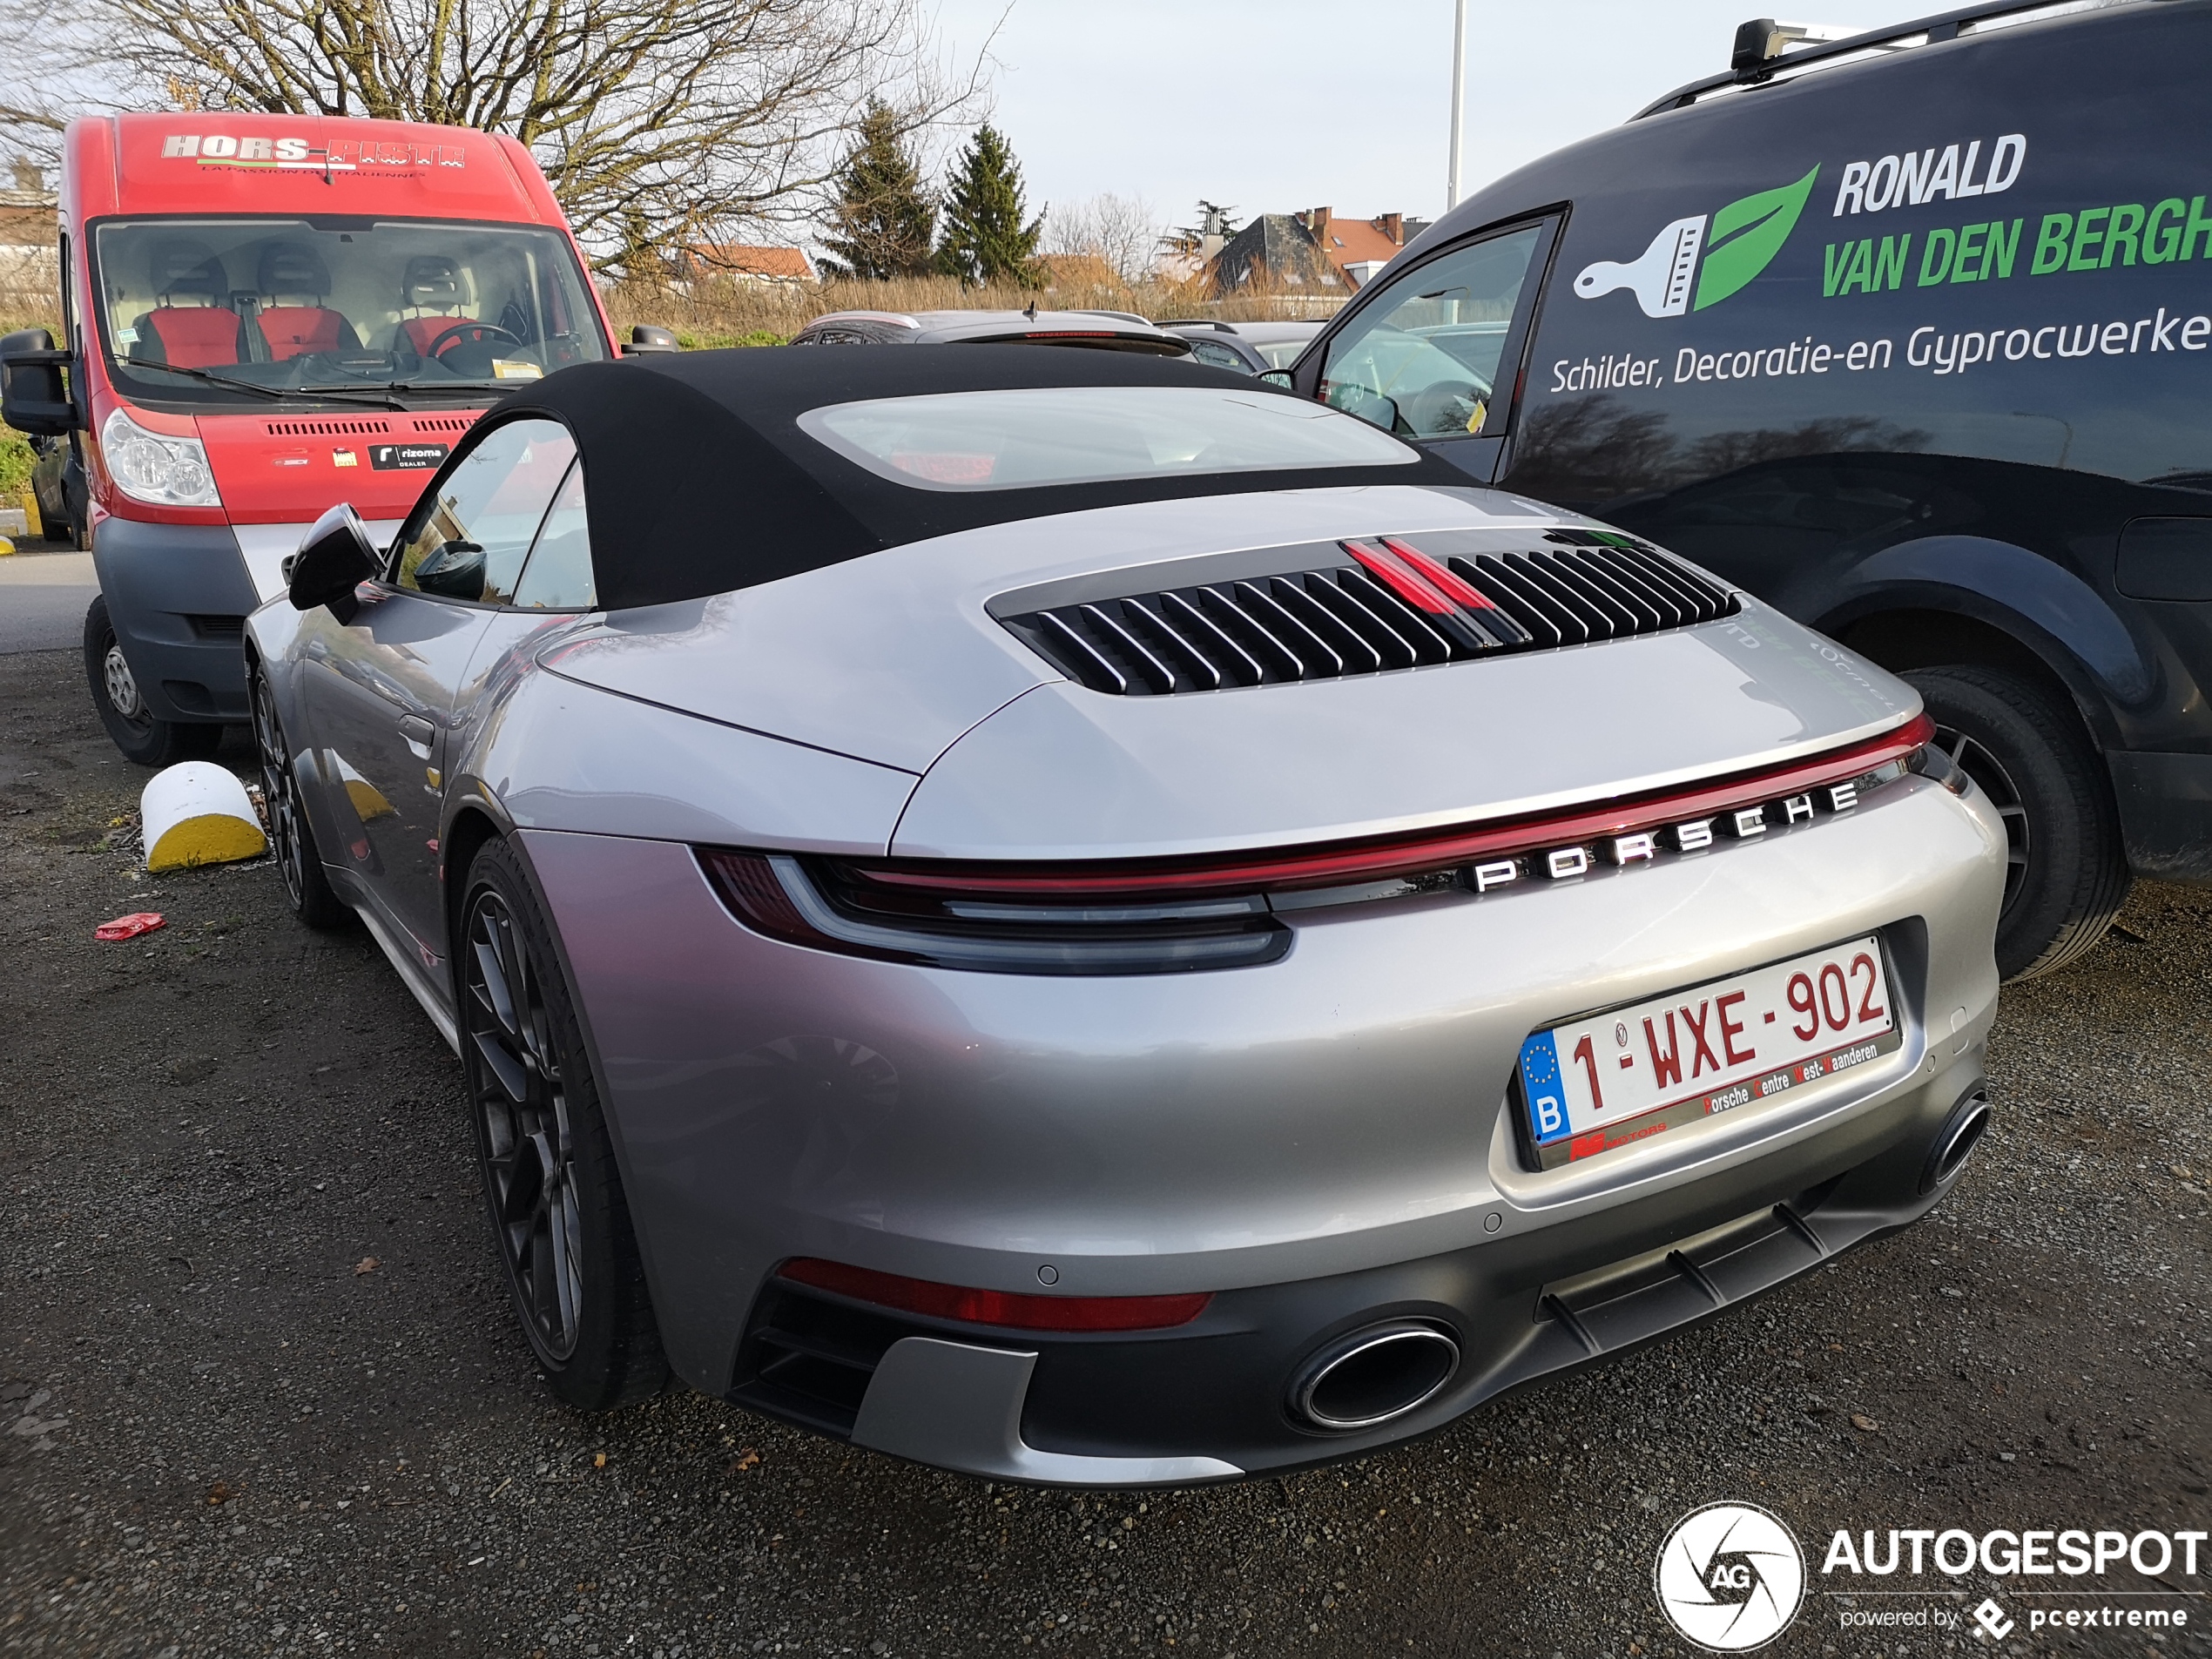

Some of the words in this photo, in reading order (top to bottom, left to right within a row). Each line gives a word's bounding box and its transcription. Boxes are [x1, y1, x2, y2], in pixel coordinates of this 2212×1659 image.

[161, 134, 465, 169] HORS-PISTE
[1832, 133, 2027, 217] RONALD
[1823, 233, 1912, 298] VAN
[1917, 218, 2024, 287] DEN
[1550, 353, 1663, 393] Schilder,
[1674, 335, 1892, 383] Decoratie-en
[401, 448, 442, 458] rizoma
[1474, 782, 1859, 893] PORSCHE
[1536, 1096, 1562, 1134] B
[1703, 1087, 1750, 1116] Porsche
[1753, 1074, 1790, 1099] Centre
[1606, 1122, 1667, 1149] MOTORS
